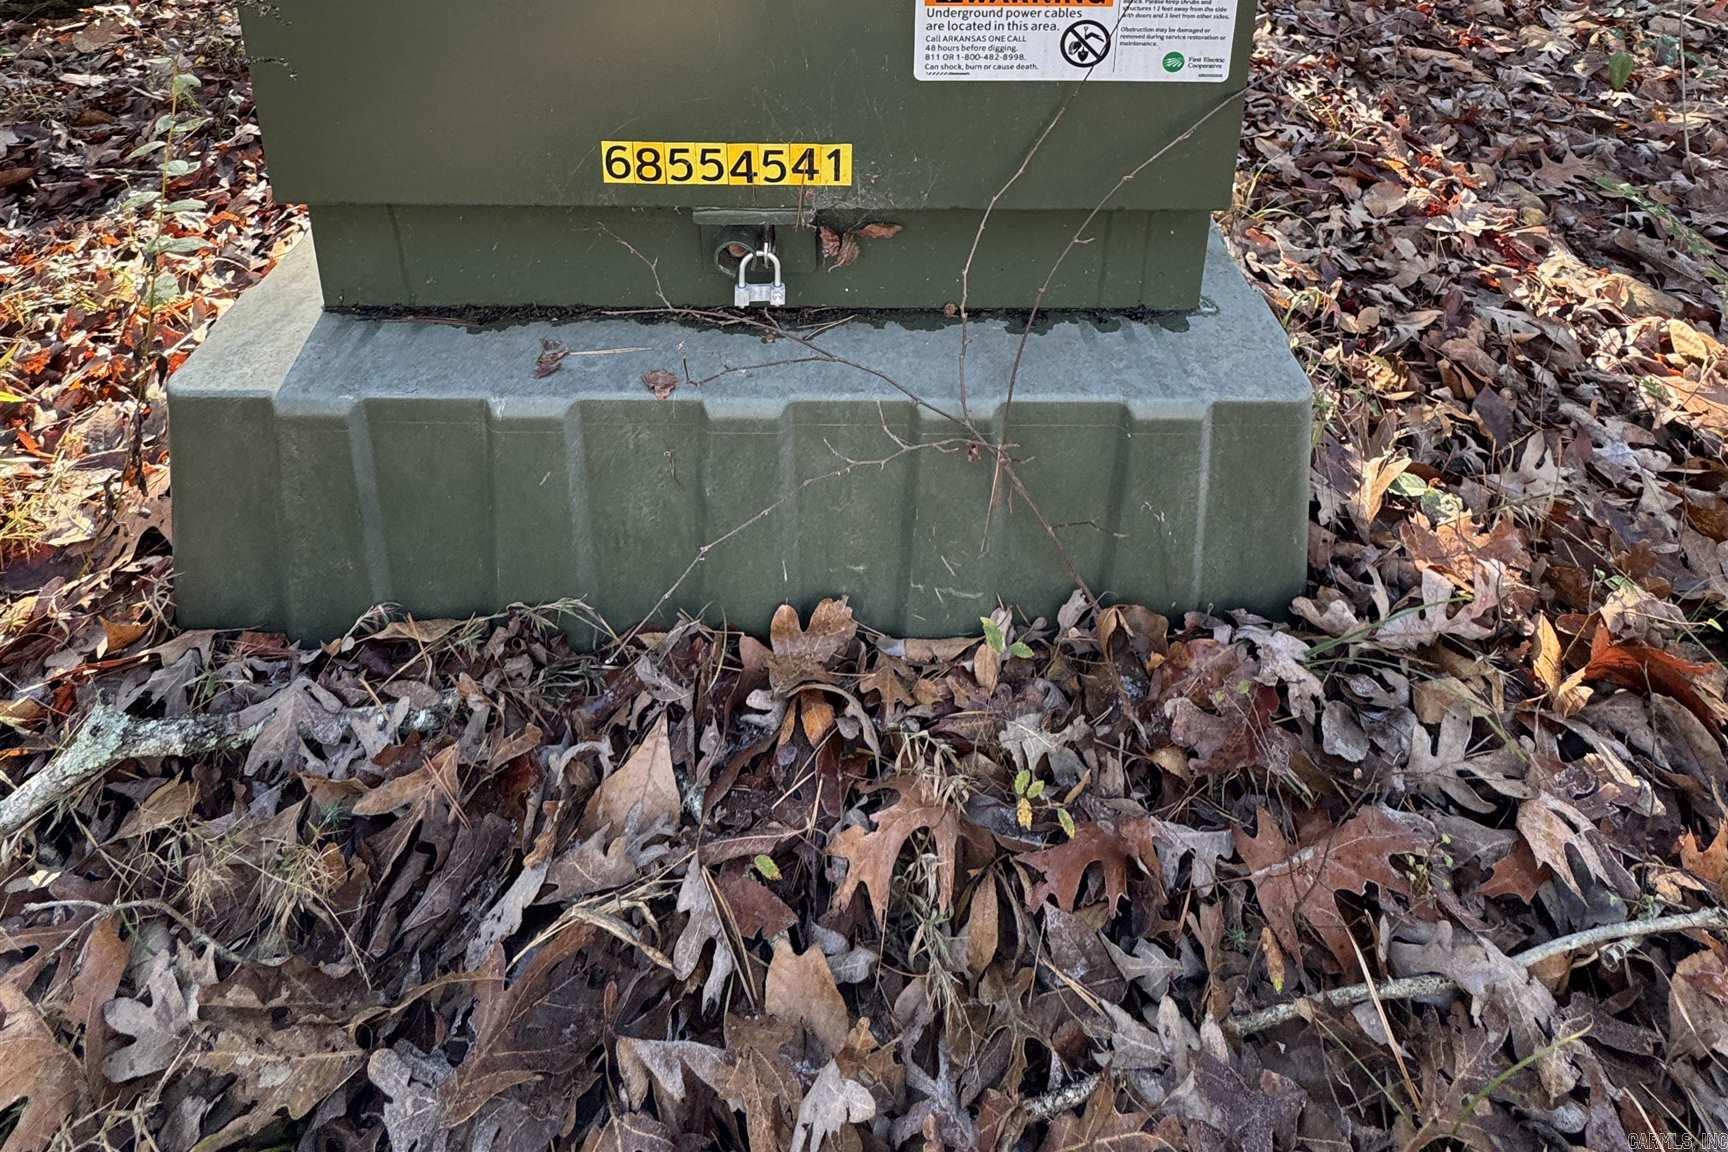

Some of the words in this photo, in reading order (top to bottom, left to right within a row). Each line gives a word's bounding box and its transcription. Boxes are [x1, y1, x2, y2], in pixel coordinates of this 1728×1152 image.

[927, 8, 1003, 20] Underground
[1006, 10, 1042, 20] power
[1044, 8, 1082, 18] cables
[926, 23, 944, 31] are
[948, 21, 991, 31] located
[994, 21, 1004, 31] in
[1007, 21, 1028, 31] this
[1031, 23, 1060, 31] area.
[988, 44, 1018, 53] digging.
[940, 63, 964, 71] shock,
[605, 146, 841, 183] 68554541
